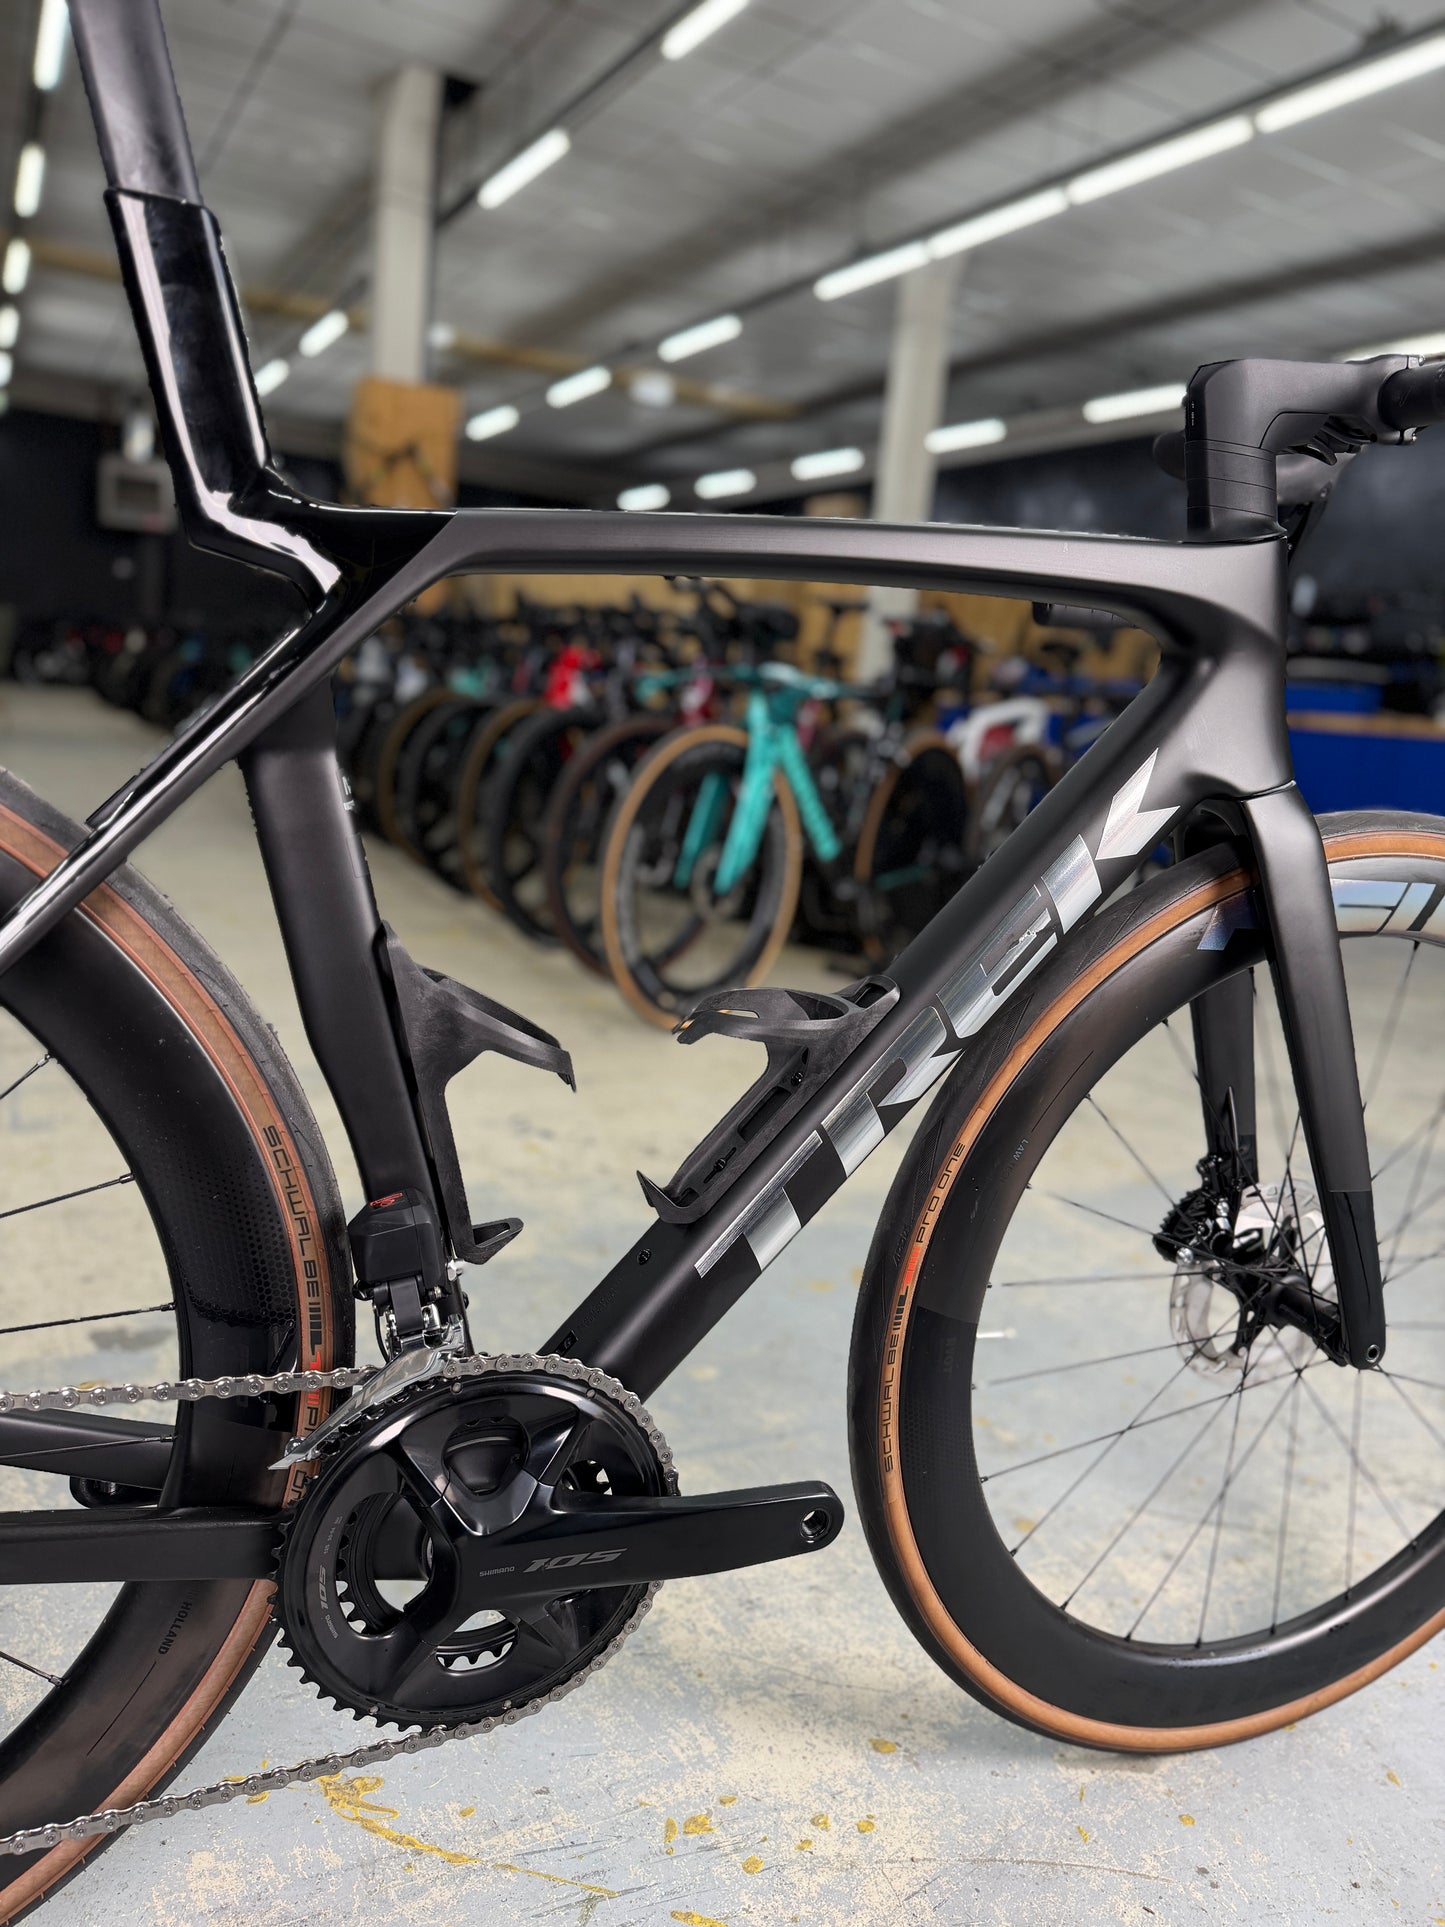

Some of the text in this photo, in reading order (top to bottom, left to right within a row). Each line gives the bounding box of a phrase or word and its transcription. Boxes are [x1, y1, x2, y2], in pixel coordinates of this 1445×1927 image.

[694, 748, 1180, 1276] TREK
[1013, 1138, 1029, 1161] LAW
[263, 1125, 320, 1298] SCHWALBE
[883, 1334, 900, 1472] SCHWALBE
[319, 1564, 329, 1609] 105
[479, 1547, 628, 1577] SHIMANO 105
[158, 1601, 193, 1655] HOLLAND
